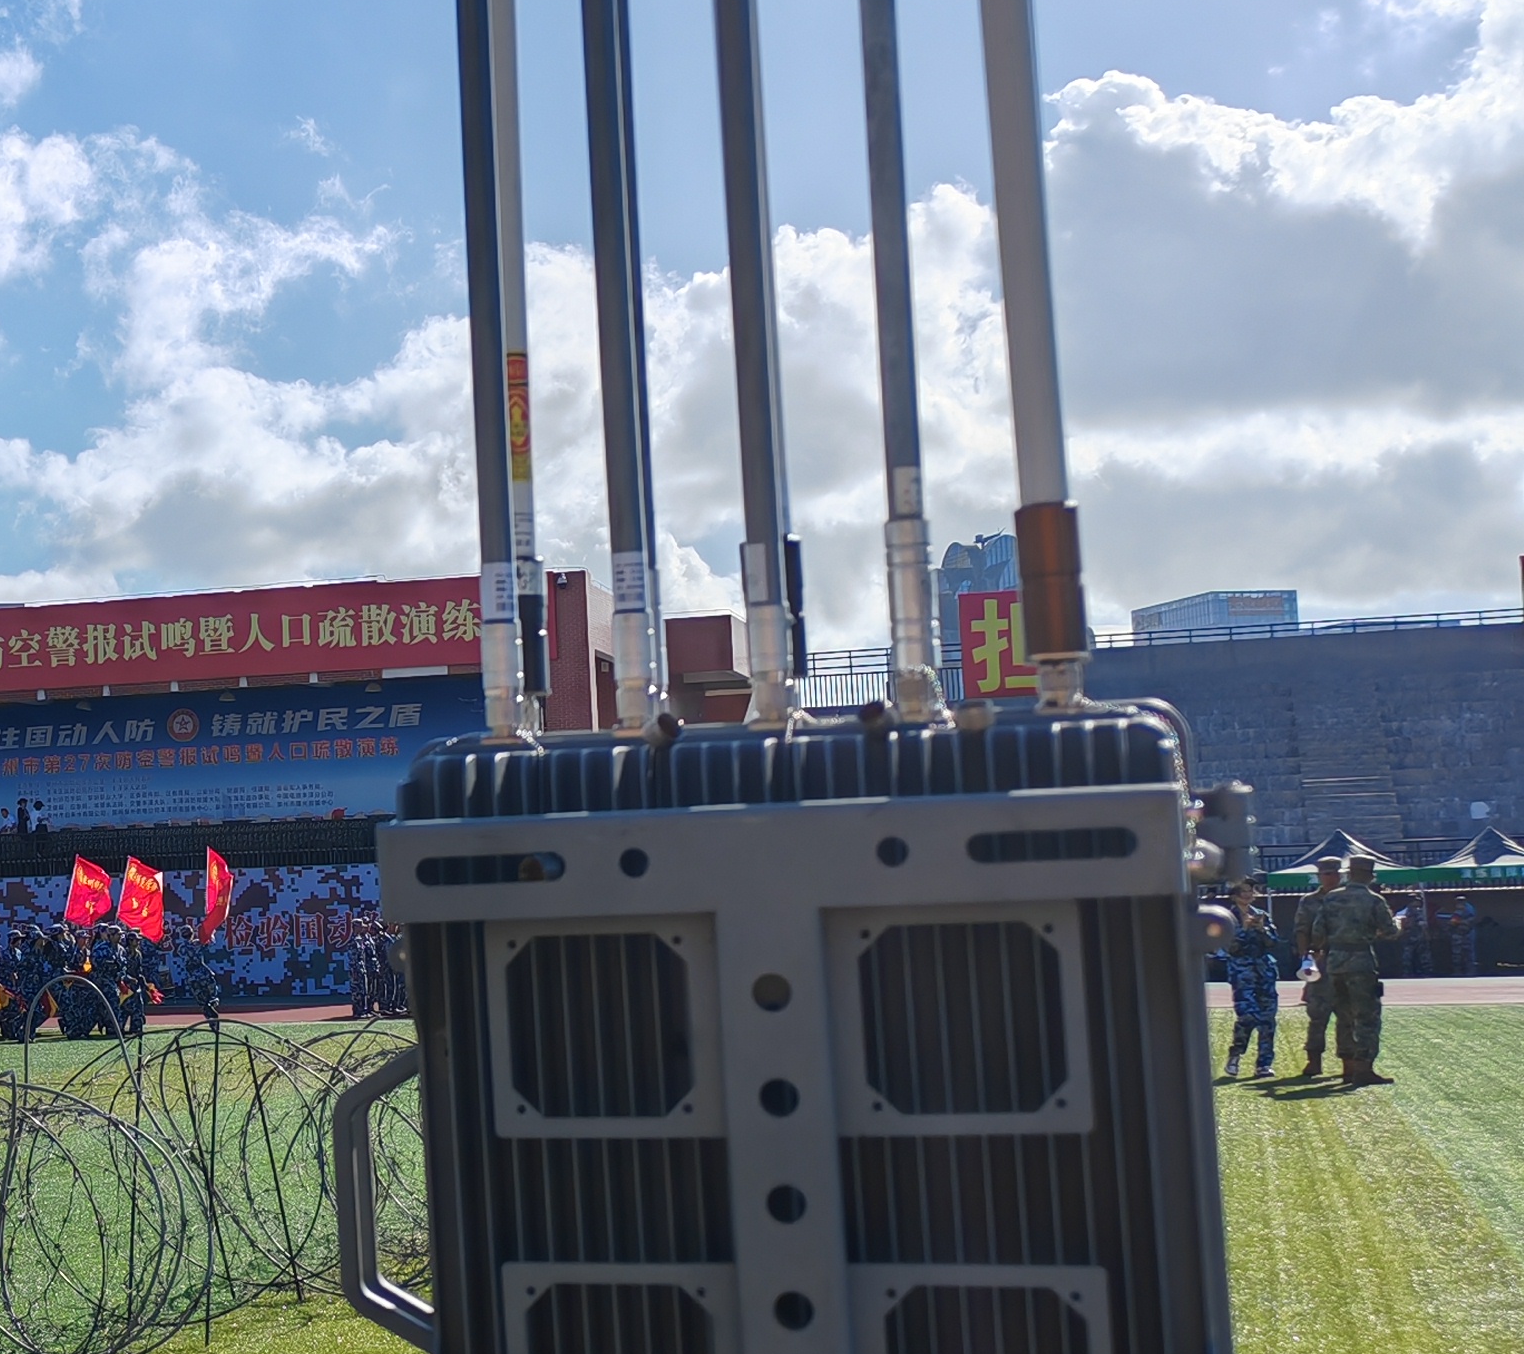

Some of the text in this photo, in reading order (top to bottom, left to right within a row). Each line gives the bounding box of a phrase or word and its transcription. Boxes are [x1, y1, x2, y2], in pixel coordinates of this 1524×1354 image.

[211, 702, 424, 737] 铸就护民之盾
[224, 909, 381, 951] 检验国动
